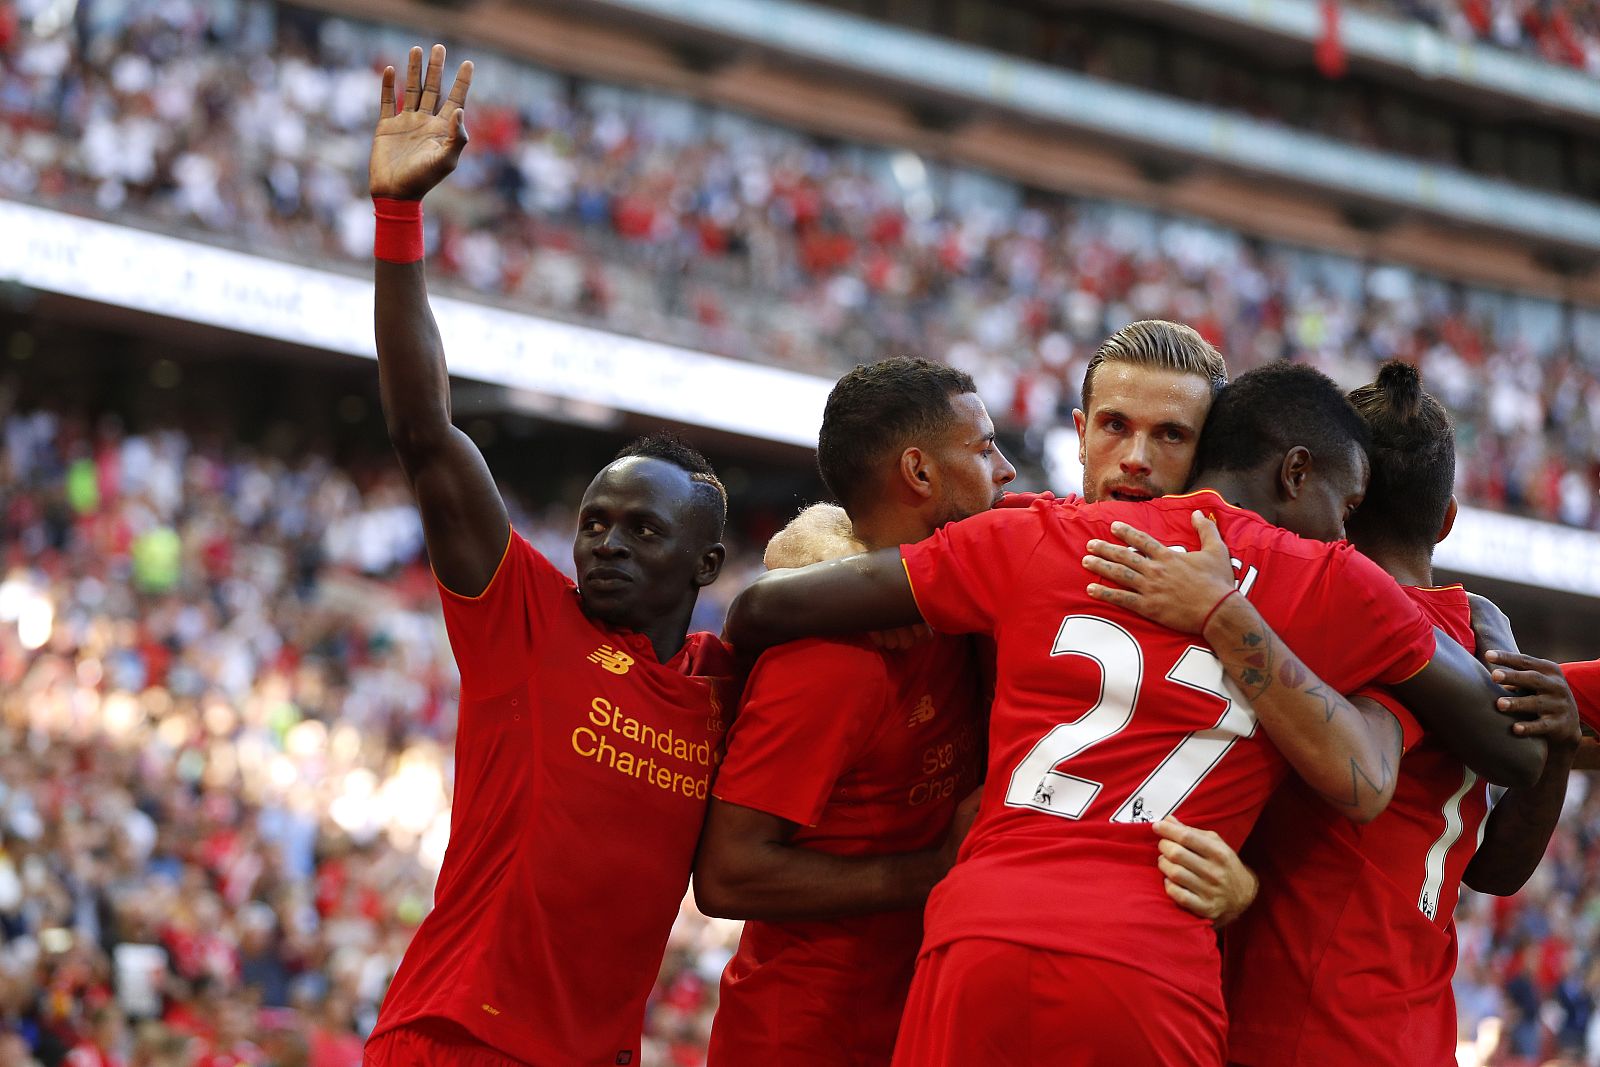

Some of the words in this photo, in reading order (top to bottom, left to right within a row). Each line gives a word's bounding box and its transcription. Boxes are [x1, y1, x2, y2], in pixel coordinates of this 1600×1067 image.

[589, 697, 710, 766] Standard
[1004, 614, 1258, 824] 27
[572, 727, 709, 800] Chartered
